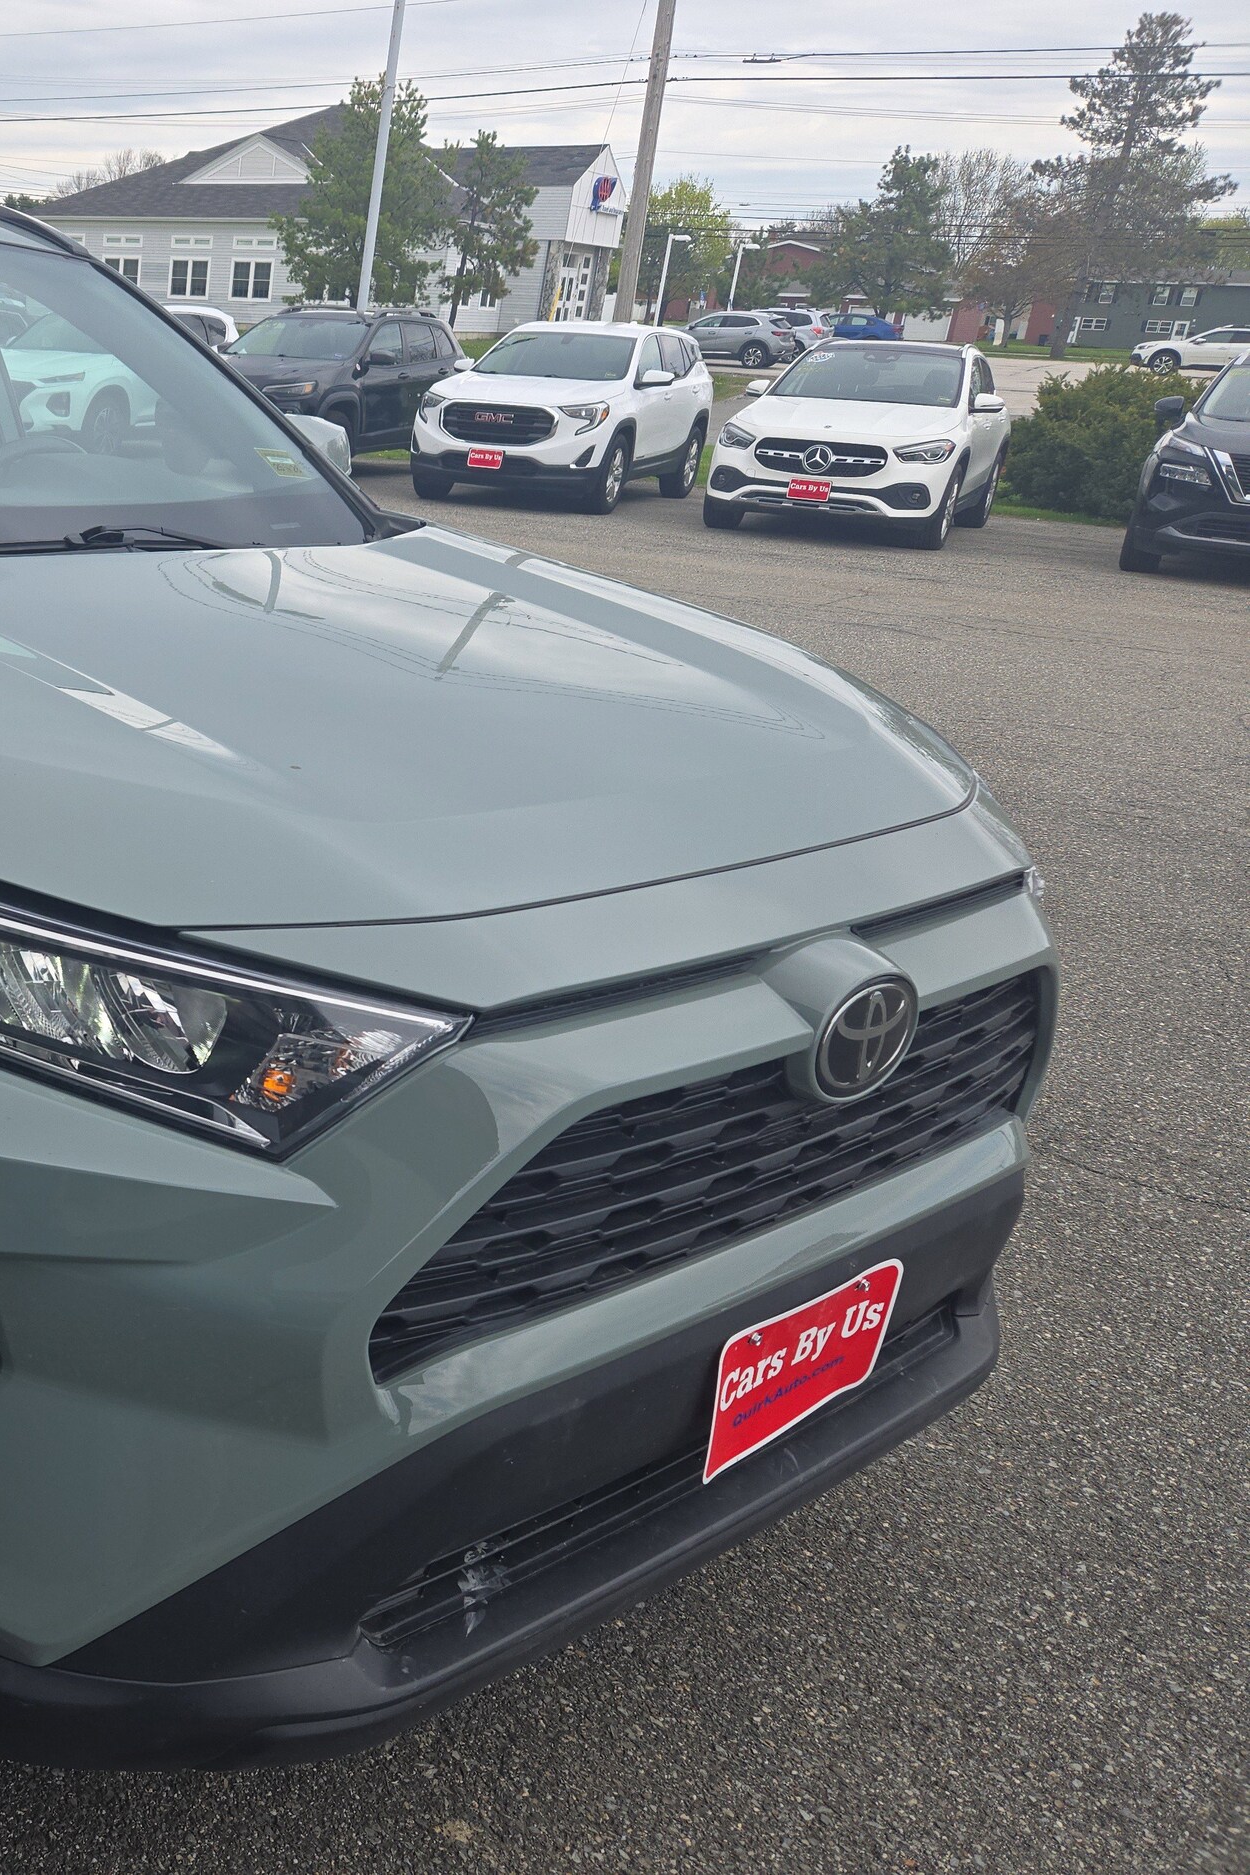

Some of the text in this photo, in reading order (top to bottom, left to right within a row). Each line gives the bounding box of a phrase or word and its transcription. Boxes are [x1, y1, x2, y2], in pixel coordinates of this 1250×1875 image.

[475, 412, 514, 424] GMC
[808, 485, 818, 493] By
[720, 1300, 885, 1411] Cars By Us
[733, 1356, 845, 1428] QuirkAuto.com
